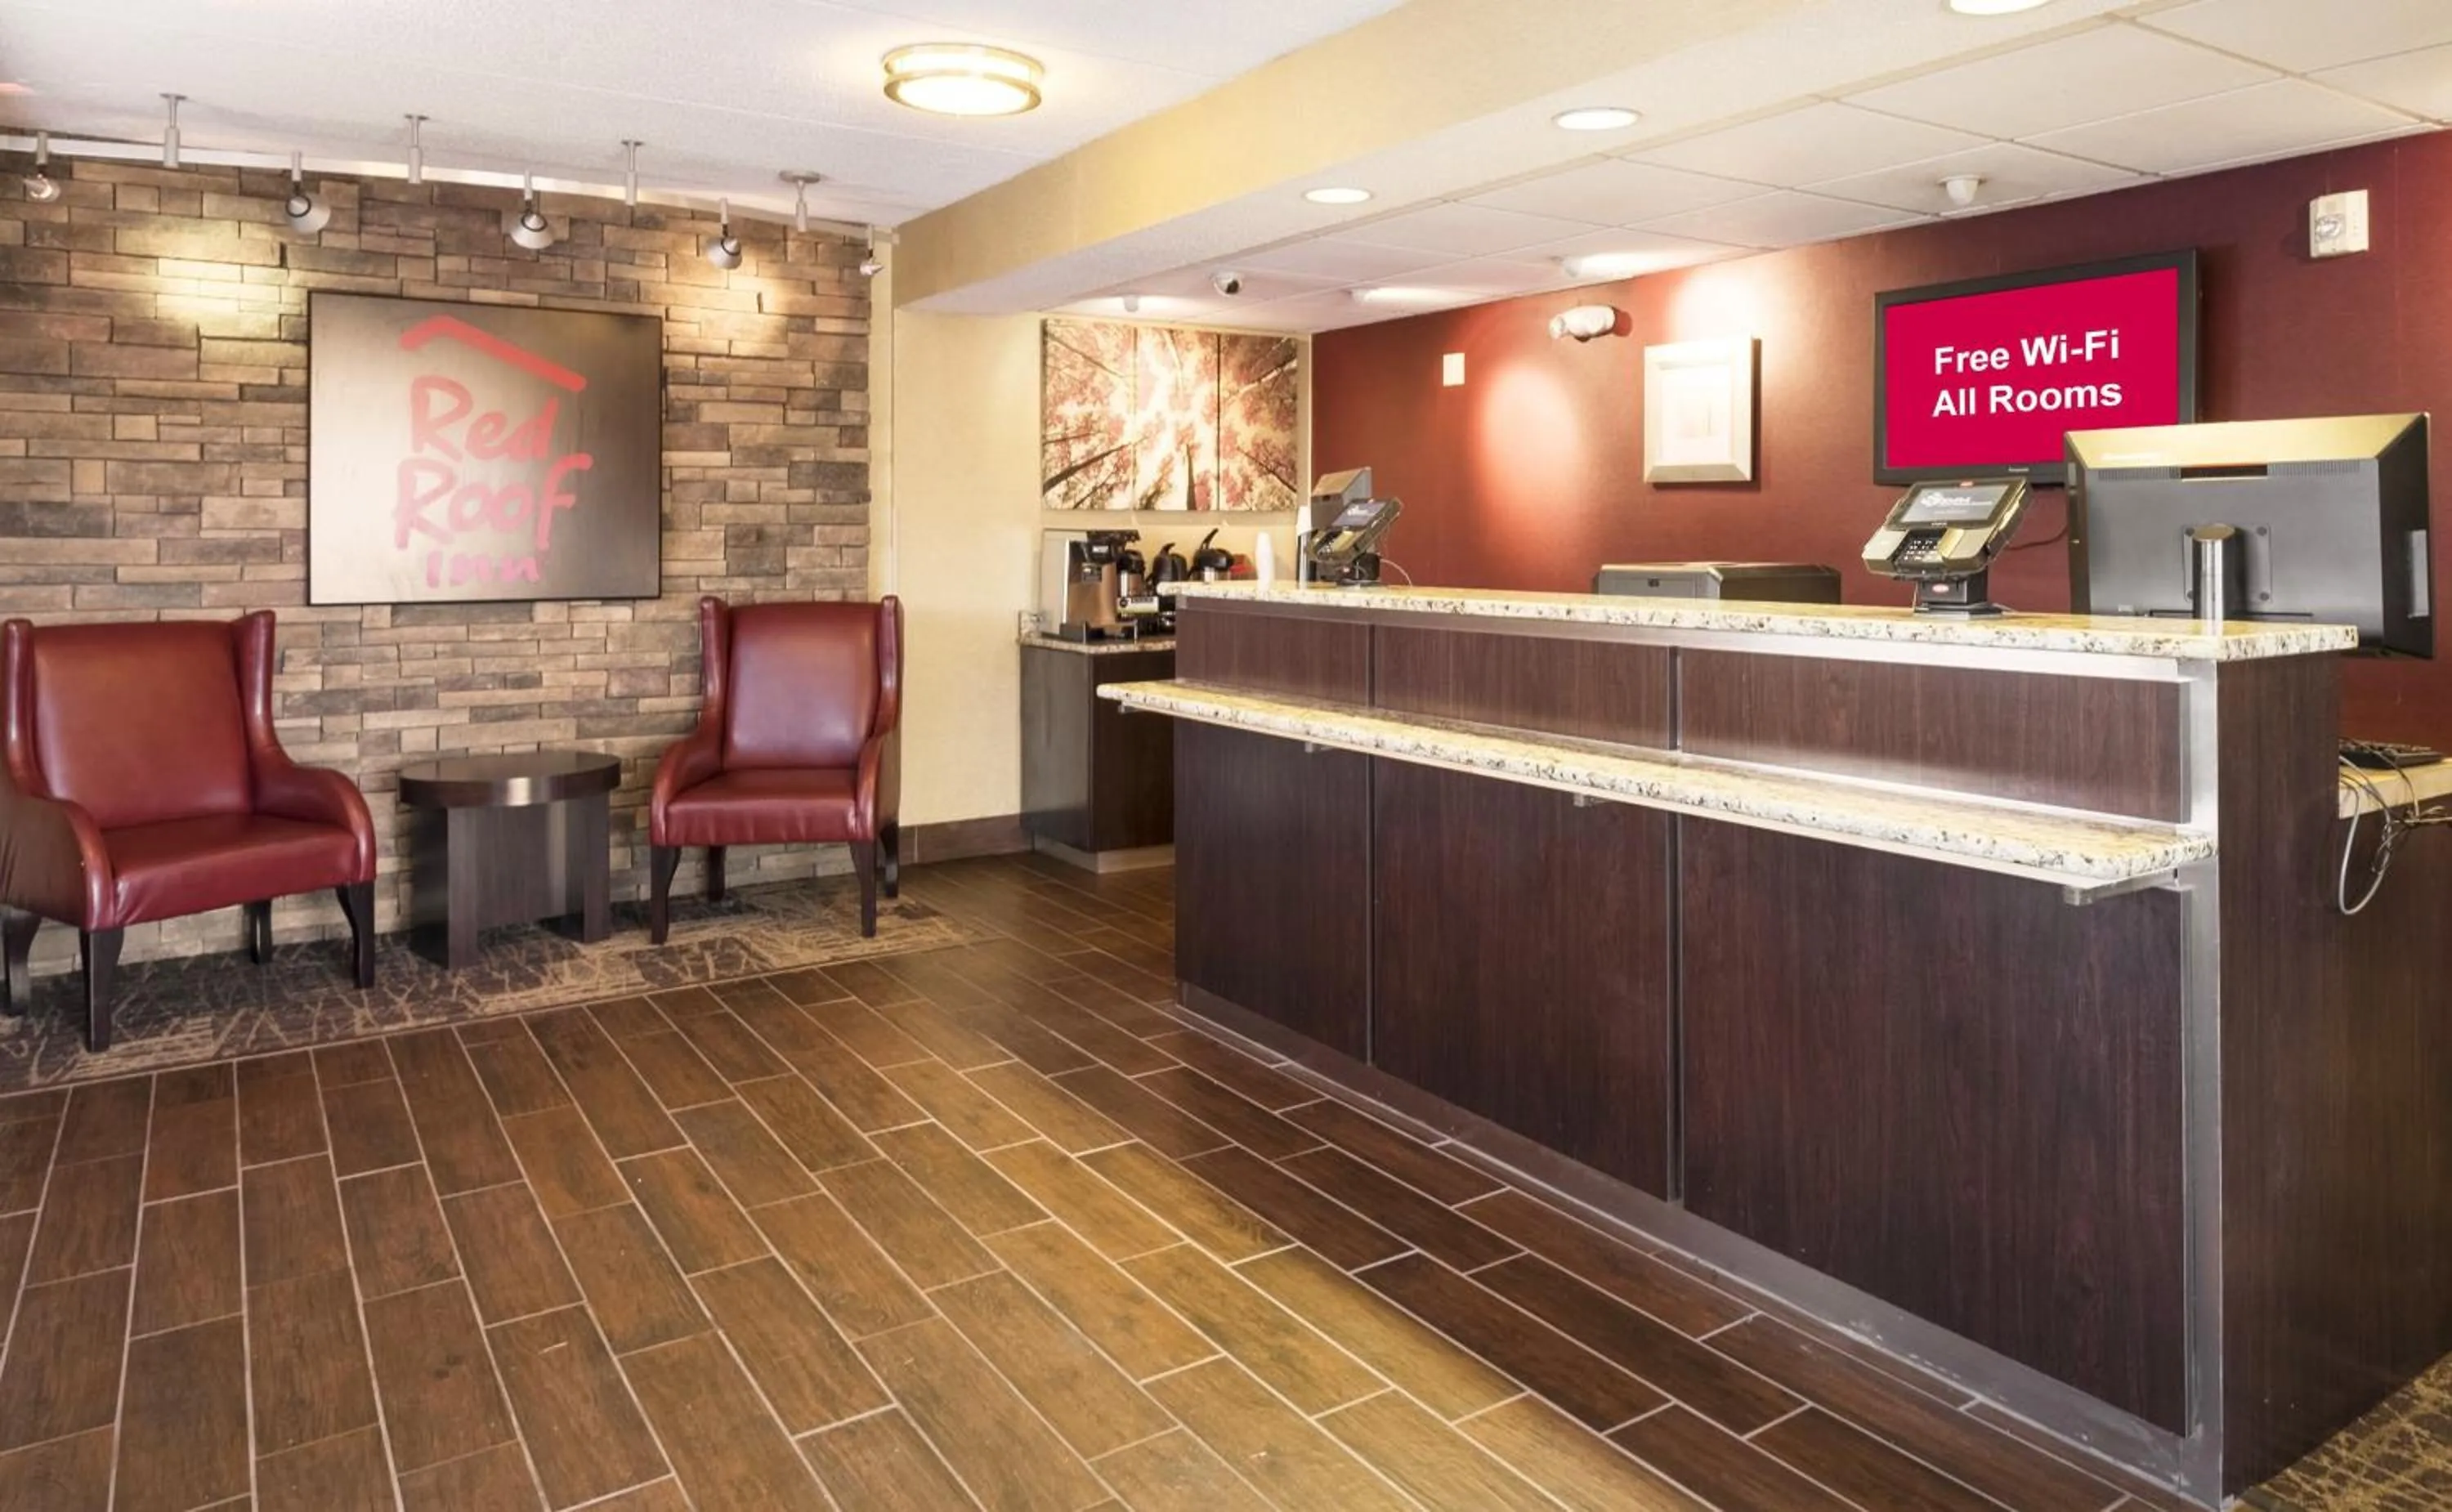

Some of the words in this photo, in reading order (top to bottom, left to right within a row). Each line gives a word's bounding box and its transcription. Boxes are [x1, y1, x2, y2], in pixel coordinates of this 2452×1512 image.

[1935, 346, 2010, 375] Free
[2020, 329, 2119, 367] Wi-Fi
[410, 374, 559, 463] Red
[1932, 387, 1975, 418] All
[1989, 383, 2123, 414] Rooms
[394, 454, 594, 551] Roof
